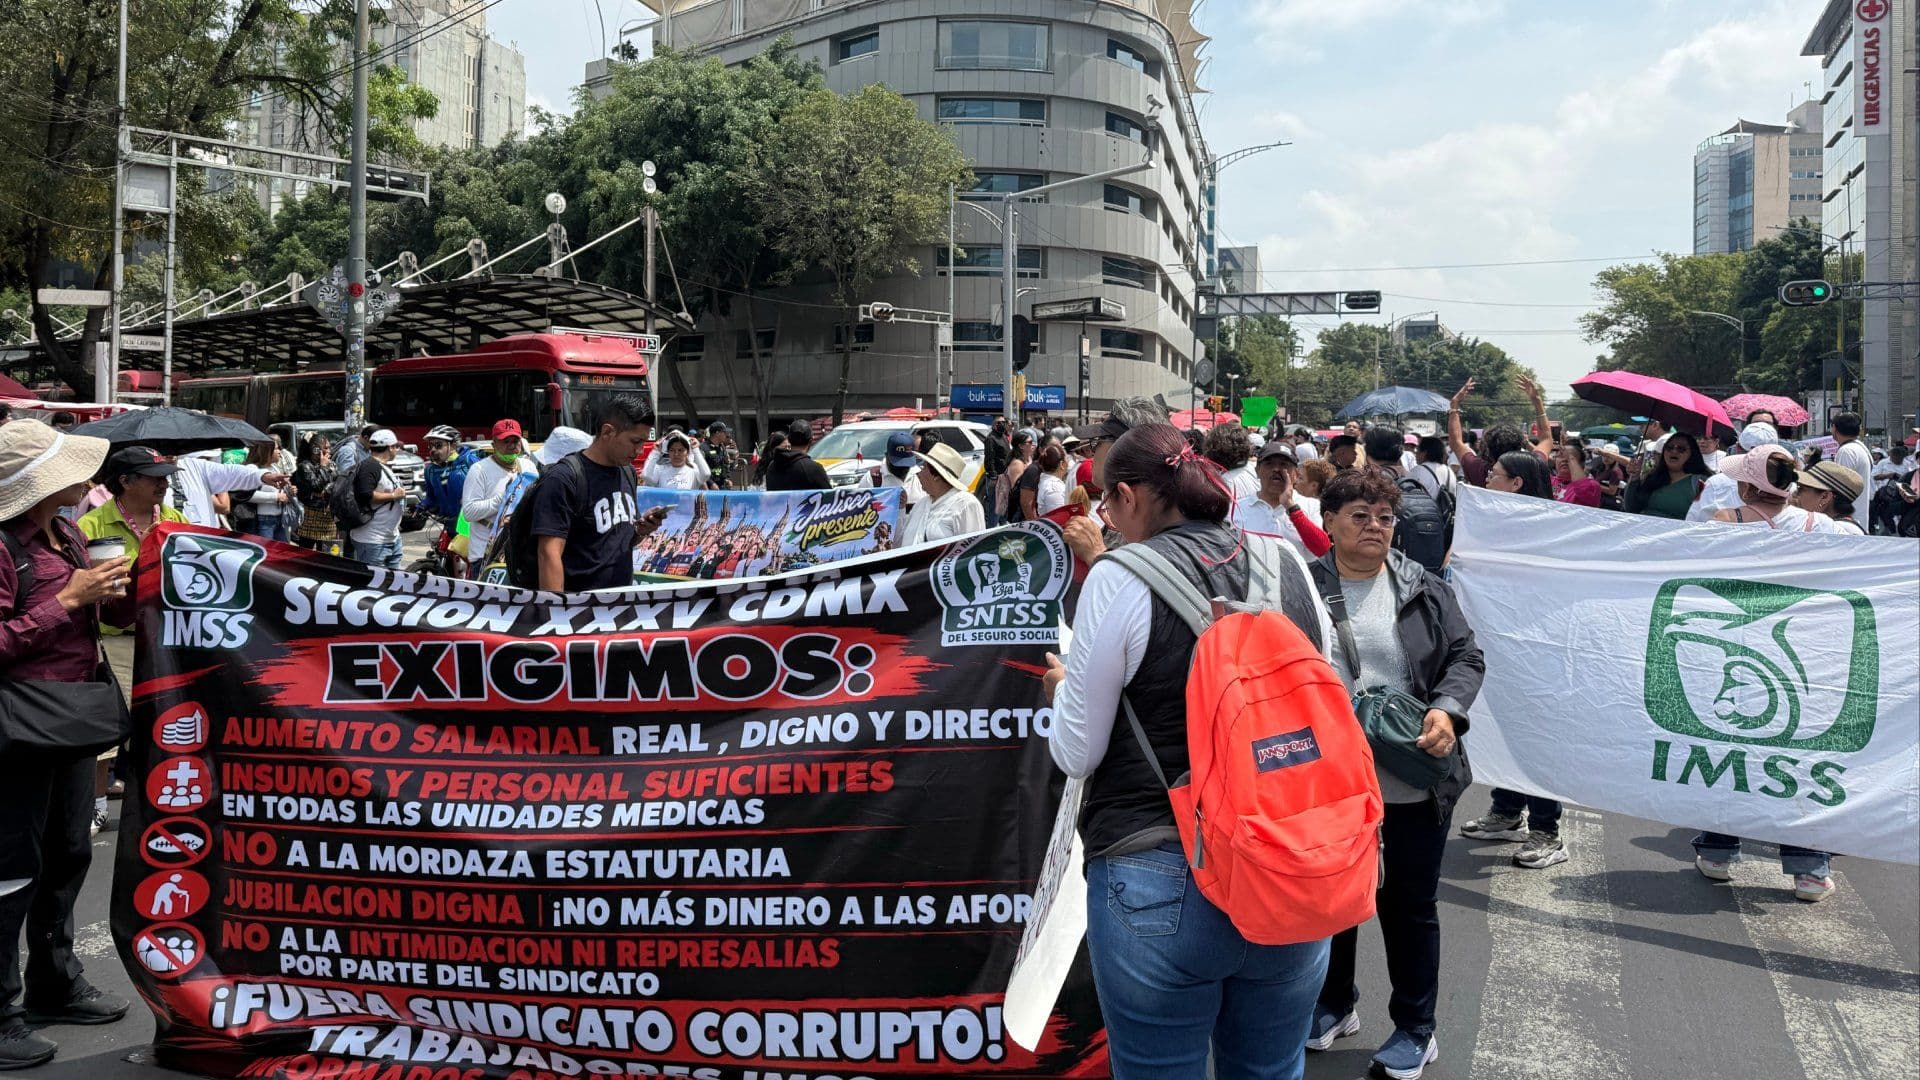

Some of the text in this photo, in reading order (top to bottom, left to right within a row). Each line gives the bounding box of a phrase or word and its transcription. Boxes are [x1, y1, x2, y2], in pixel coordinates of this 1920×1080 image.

[1864, 27, 1881, 126] URGENCIAS
[968, 390, 986, 402] buk
[1027, 389, 1044, 403] buk
[796, 488, 871, 532] Jalisco
[801, 507, 878, 550] presente
[1028, 522, 1064, 579] TRABAJADORES
[283, 568, 909, 635] SECCION XXXV CDMX
[956, 602, 1047, 629] SNTSS
[162, 610, 254, 649] IMSS
[947, 630, 1058, 643] DEL SEGURO SOCIAL
[323, 632, 877, 704] EXIGIMOS:
[222, 716, 402, 751] AUMENTO
[409, 724, 600, 755] SALARIAL
[613, 722, 709, 755] REAL
[740, 713, 860, 749] DIGNO
[868, 710, 895, 741] Y
[905, 707, 1054, 741] DIRECTO
[1257, 737, 1314, 763] JANSPORT
[222, 761, 895, 802] INSUMOS Y PERSONAL SUFICIENTES
[1650, 738, 1848, 807] IMSS
[222, 793, 765, 829] EN TODAS LAS UNIDADES MEDICAS
[222, 831, 791, 879] NO A LA MORDAZA ESTATUTARIA
[223, 879, 402, 920] JUBILACION
[411, 889, 524, 925] DIGNA
[552, 897, 610, 927] ¡NO
[620, 890, 695, 926] MÁS
[705, 896, 830, 926] DINERO
[839, 895, 863, 925] A
[874, 894, 936, 925] LAS
[222, 920, 840, 967] NO A LA INTIMIDACION NI REPRESALIAS
[280, 954, 660, 997] POR PARTE DEL SINDICATO
[211, 983, 1003, 1061] ¡FUERA SINDICATO CORRUPTO!
